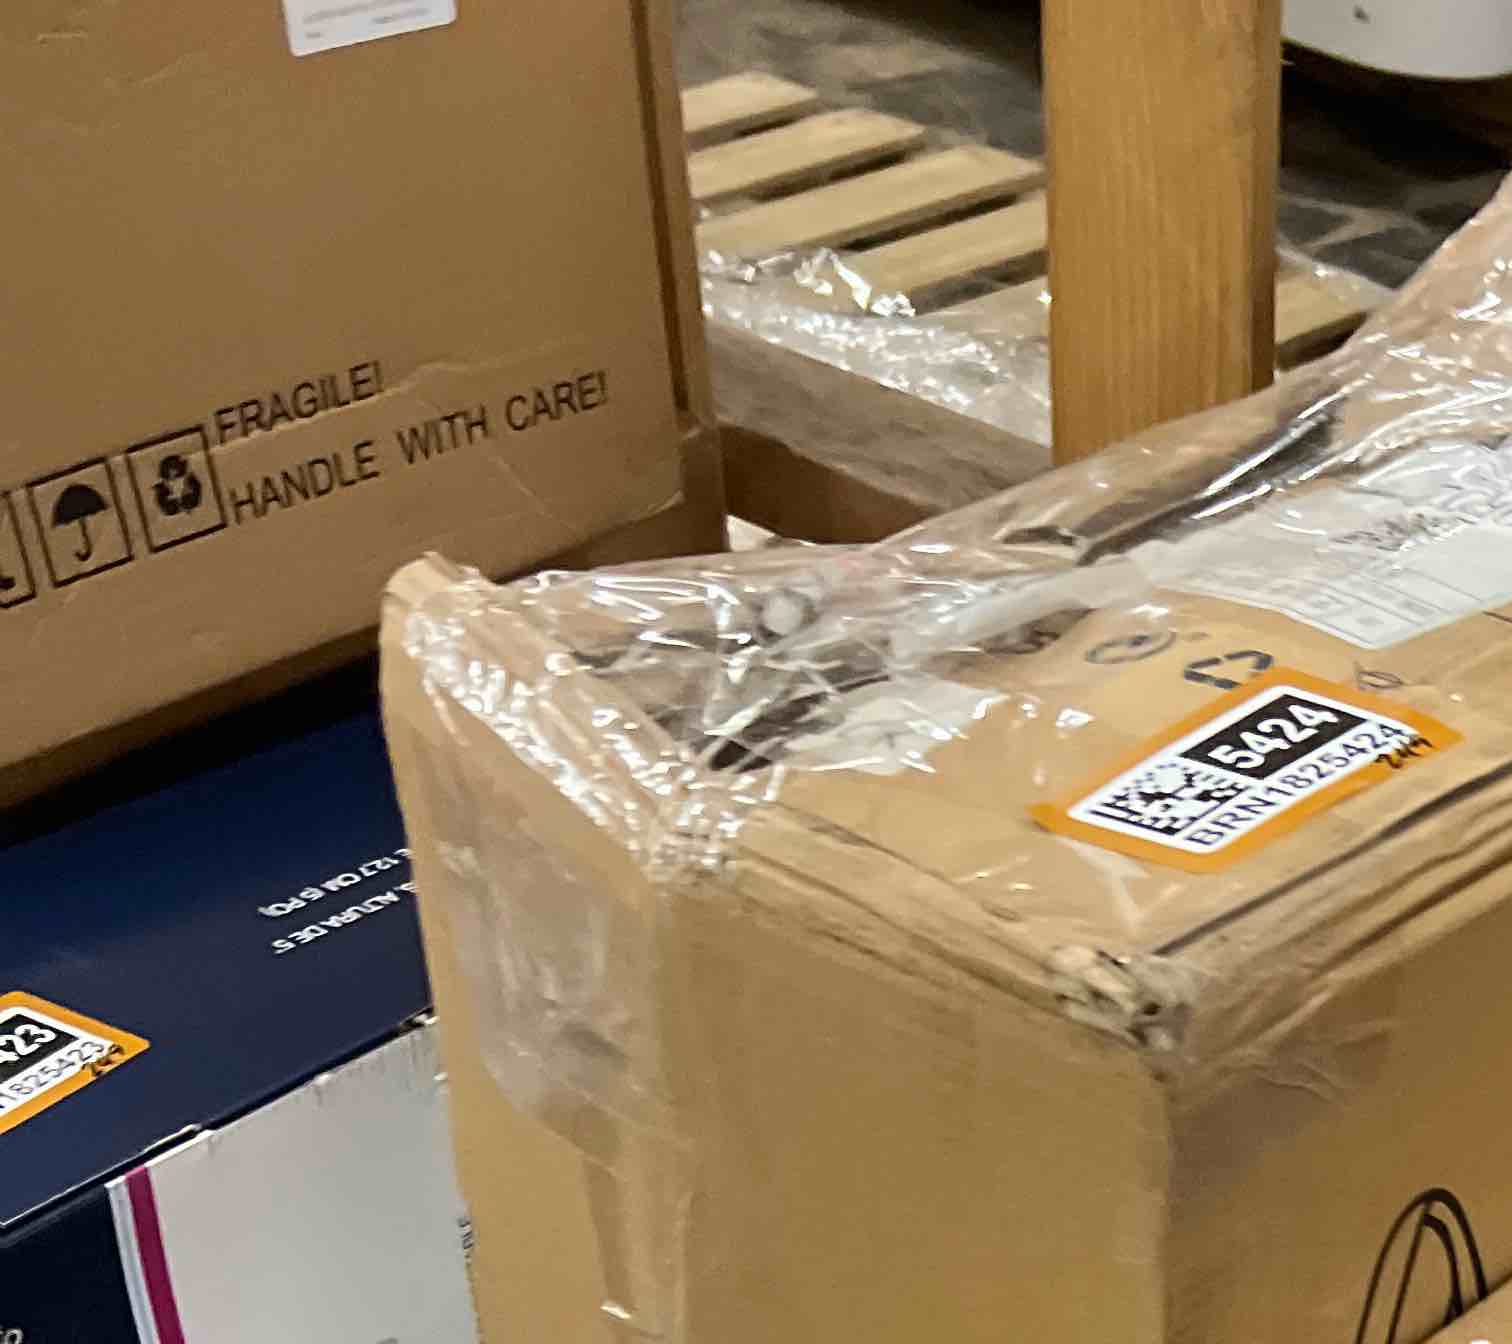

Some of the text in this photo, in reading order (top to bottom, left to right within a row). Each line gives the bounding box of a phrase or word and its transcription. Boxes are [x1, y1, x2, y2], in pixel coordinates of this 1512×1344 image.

[212, 359, 383, 444] FRAGILE!
[228, 370, 609, 526] HANDLE WITH CARE!
[1183, 721, 1406, 847] BRN1825424
[1207, 702, 1341, 770] 5424
